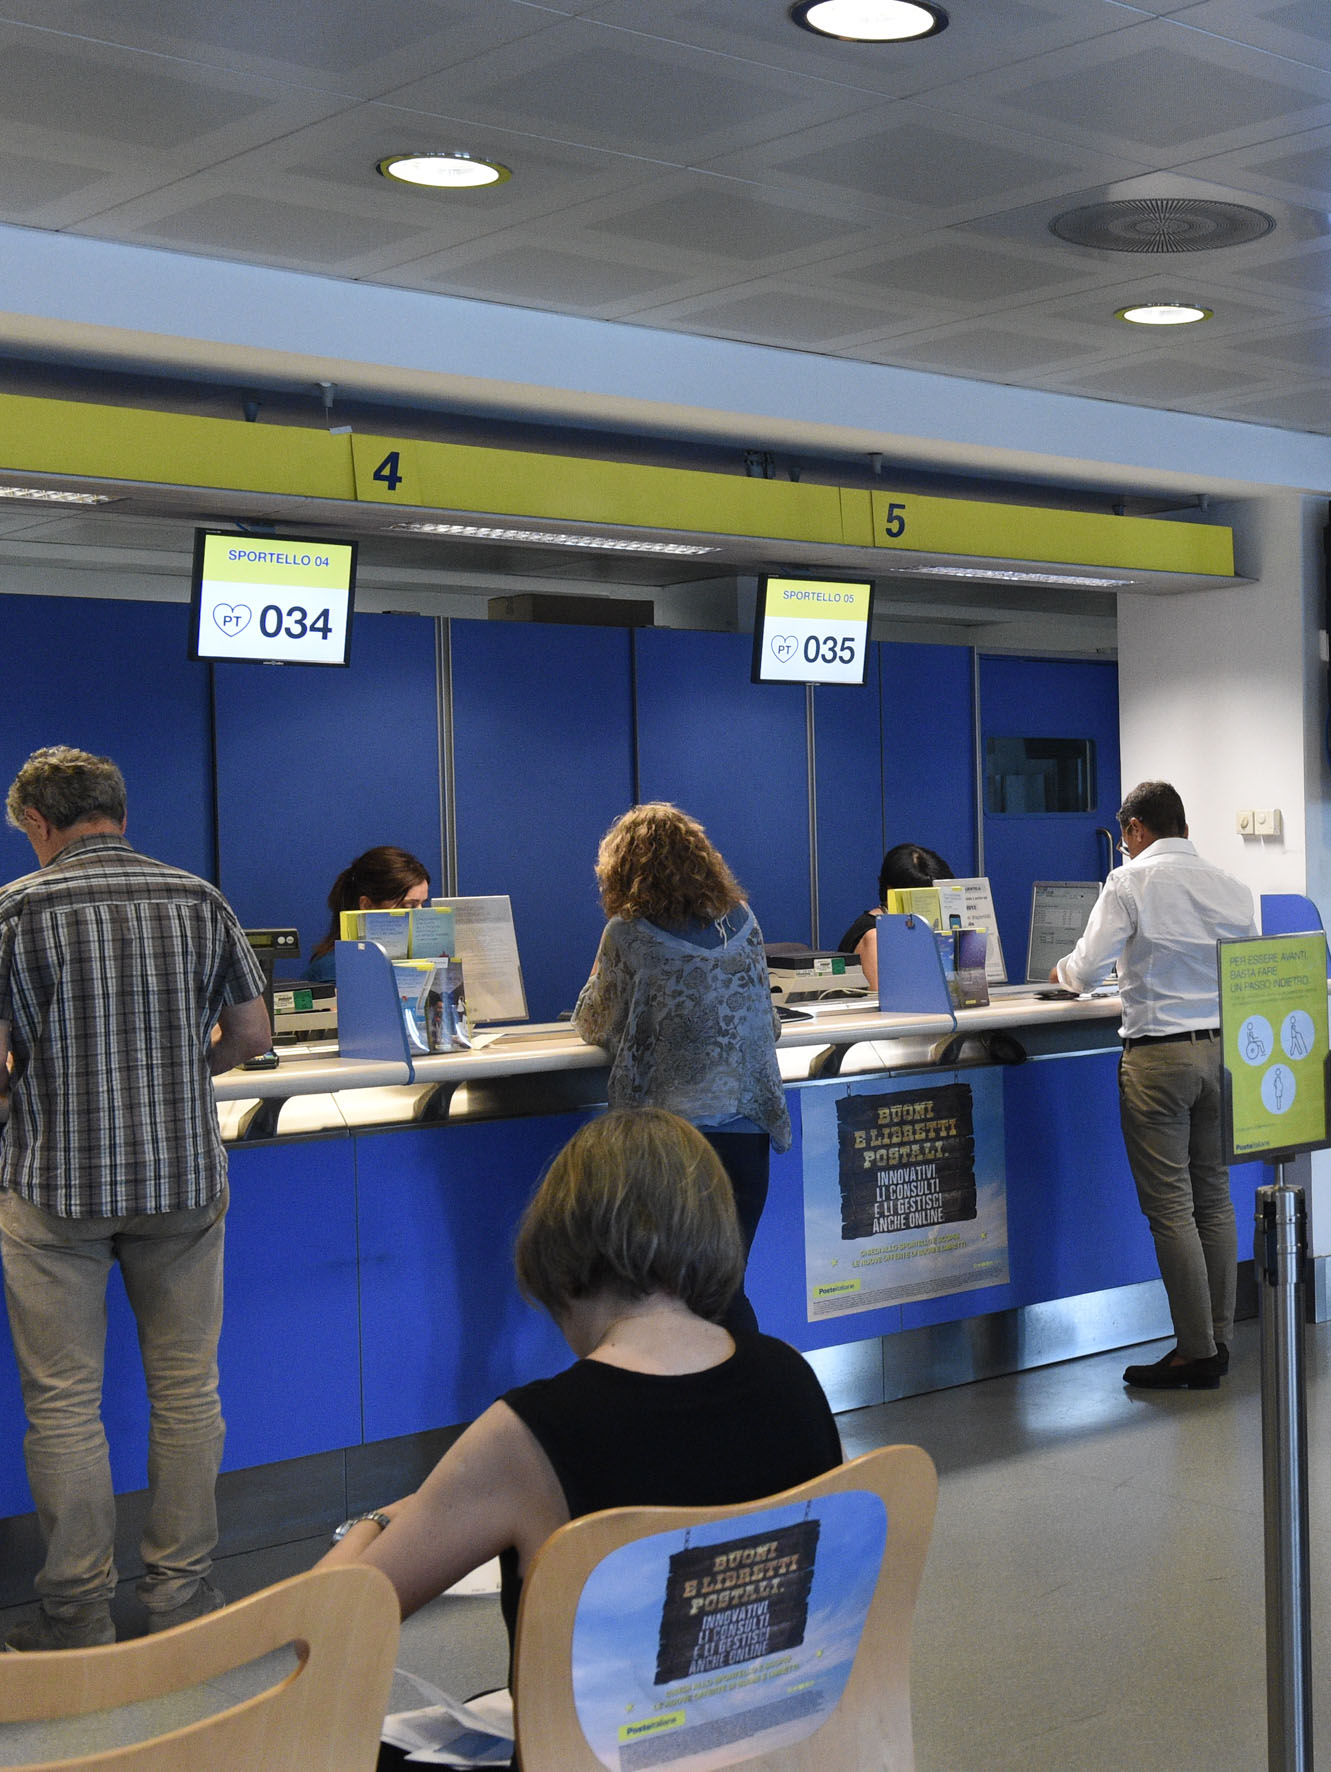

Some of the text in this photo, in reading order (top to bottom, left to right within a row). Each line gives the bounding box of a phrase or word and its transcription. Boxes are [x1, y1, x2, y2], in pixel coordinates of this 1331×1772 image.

[373, 451, 403, 491] 4
[885, 503, 906, 538] 5
[228, 549, 330, 567] SPORTELLO 04
[783, 590, 855, 603] SPORTELLO 05
[223, 604, 333, 641] PT 034
[778, 635, 856, 664] PT 035
[1247, 953, 1279, 965] ESSERE
[1244, 979, 1272, 991] PASSO
[877, 1100, 934, 1125] BUONI
[854, 1119, 957, 1149] E LIBRETTI
[863, 1141, 950, 1169] POSTALI.
[876, 1178, 940, 1202] LI CONSULTI
[874, 1192, 943, 1218] E LI GESTISCI
[872, 1214, 906, 1234] ANCHE
[713, 1541, 779, 1572] BUONI
[682, 1553, 800, 1598] E LIBRETTI
[693, 1627, 770, 1659] E LI GESTISCI
[697, 1613, 770, 1645] LI CONSULTI
[688, 1653, 725, 1675] ANCHE
